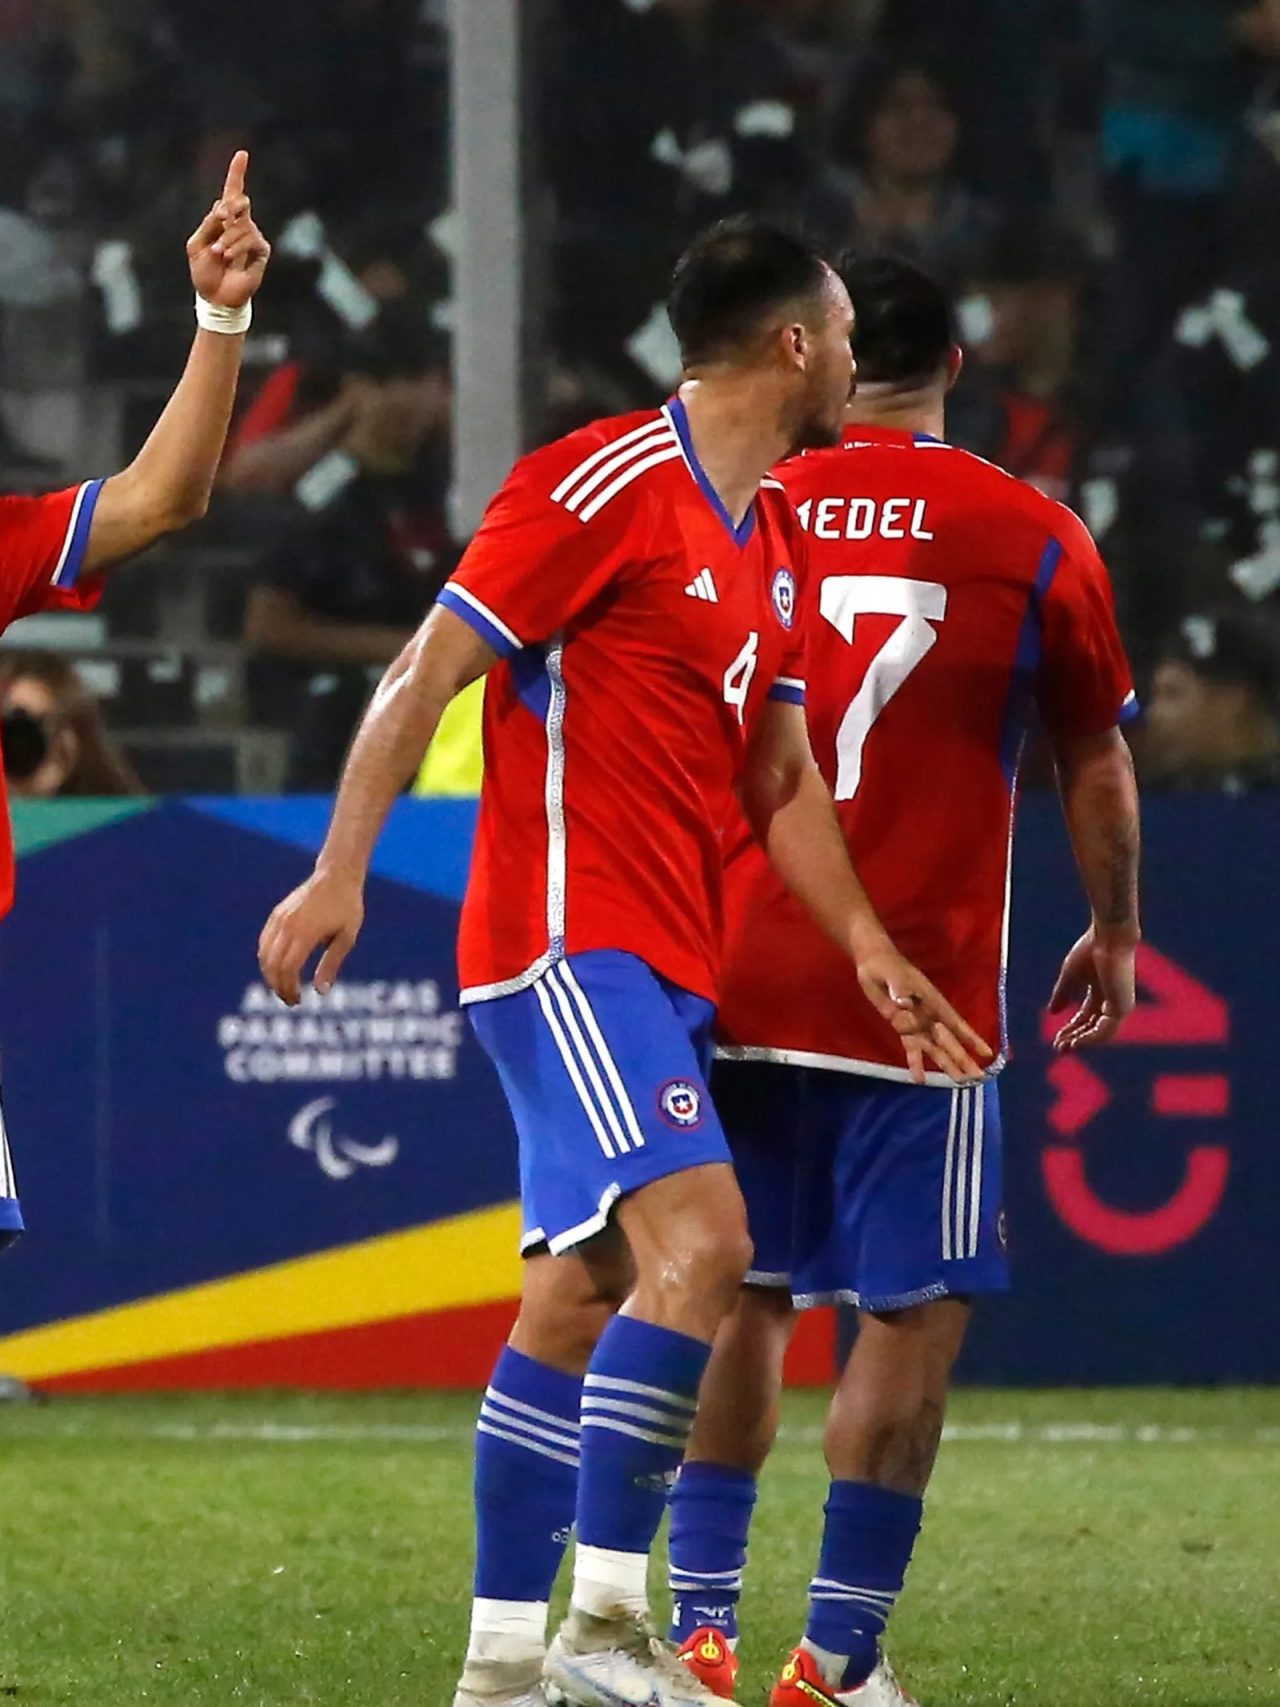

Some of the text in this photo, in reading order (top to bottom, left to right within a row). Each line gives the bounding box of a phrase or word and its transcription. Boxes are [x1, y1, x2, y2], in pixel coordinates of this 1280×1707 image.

[723, 631, 759, 726] 4
[820, 575, 948, 801] 7
[217, 1012, 463, 1049] PARALYMPIC
[224, 1048, 457, 1083] COMMITTEE
